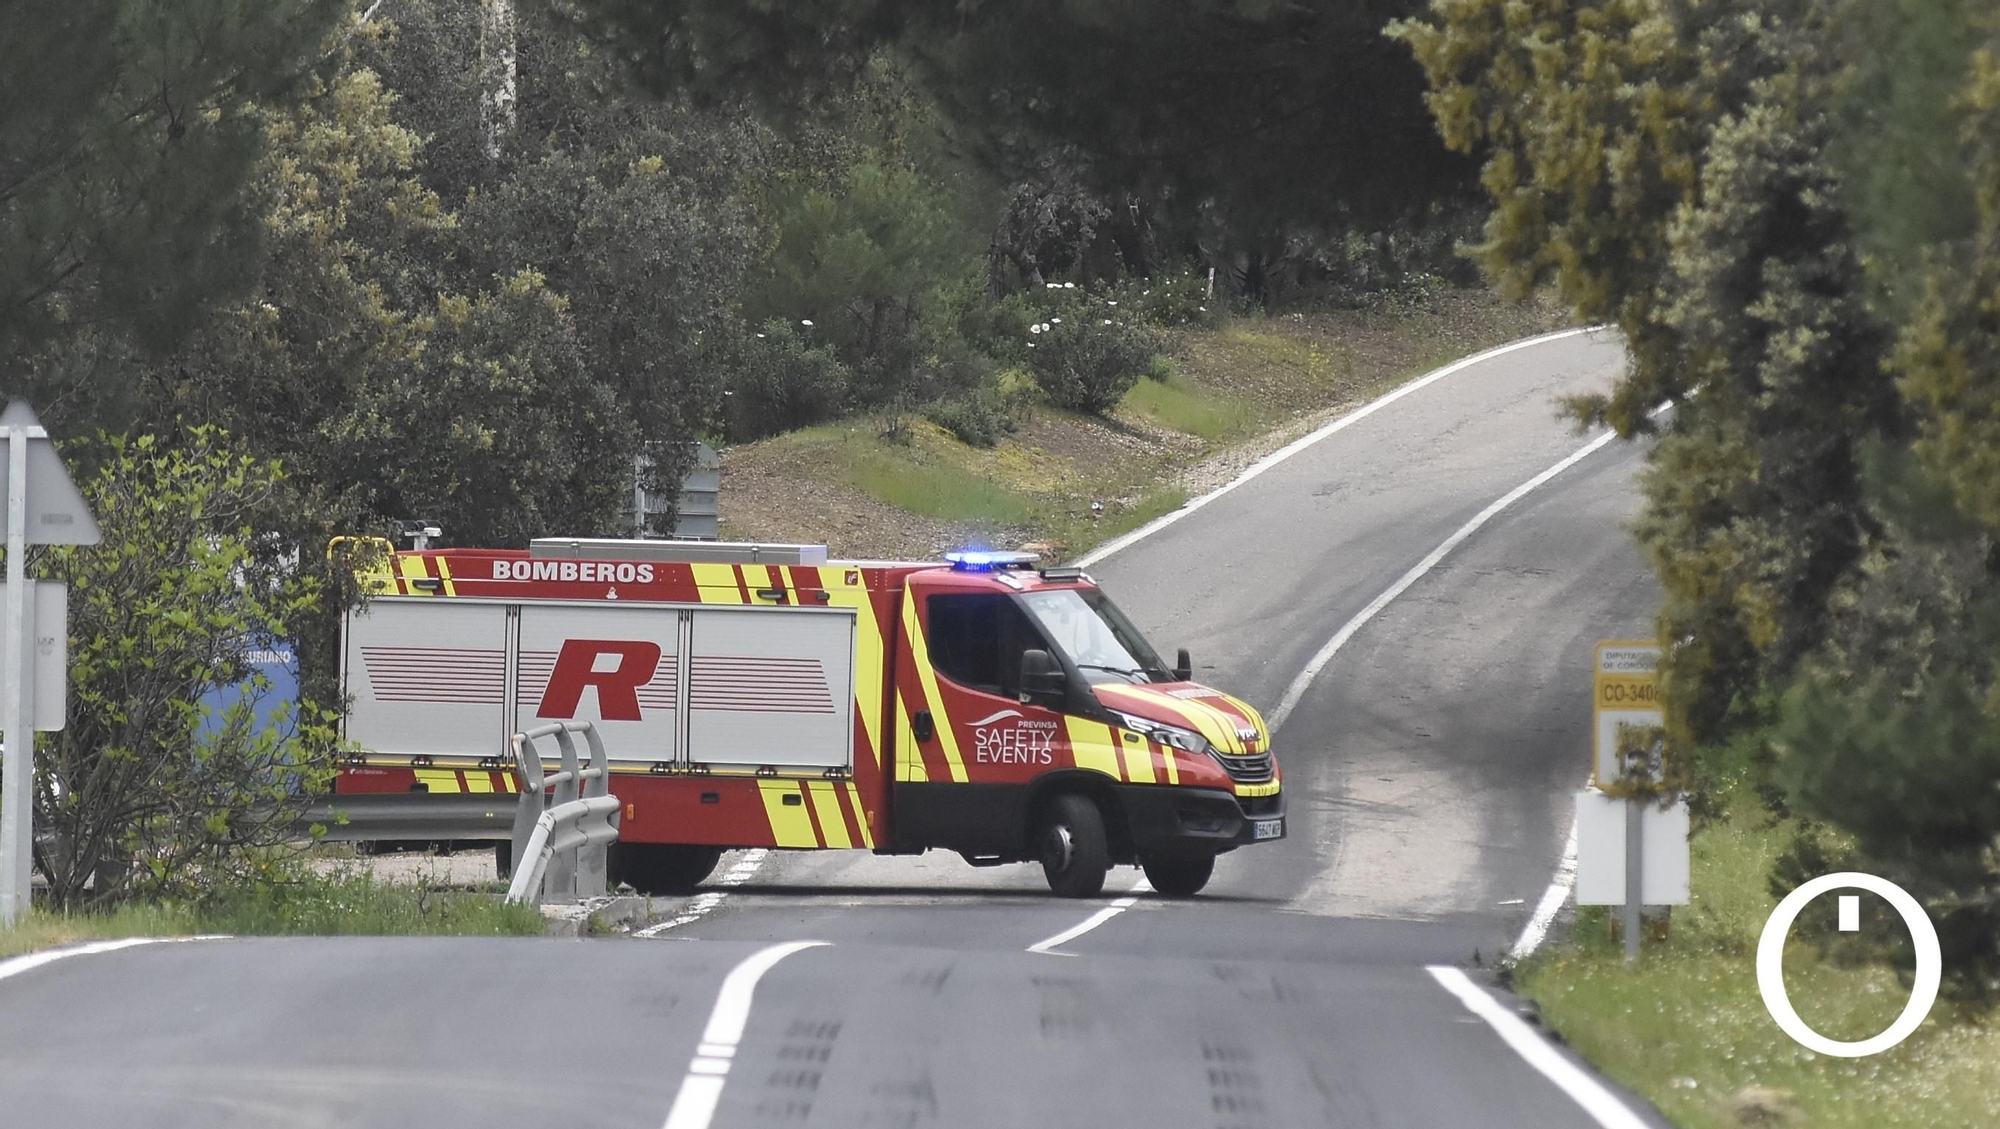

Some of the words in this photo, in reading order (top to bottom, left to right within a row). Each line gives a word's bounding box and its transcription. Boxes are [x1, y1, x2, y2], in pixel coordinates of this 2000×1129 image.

[493, 560, 654, 583] BOMBEROS
[536, 639, 662, 721] R
[1018, 720, 1058, 730] PREVINSA
[975, 728, 1055, 748] SAFETY
[977, 746, 1053, 765] EVENTS
